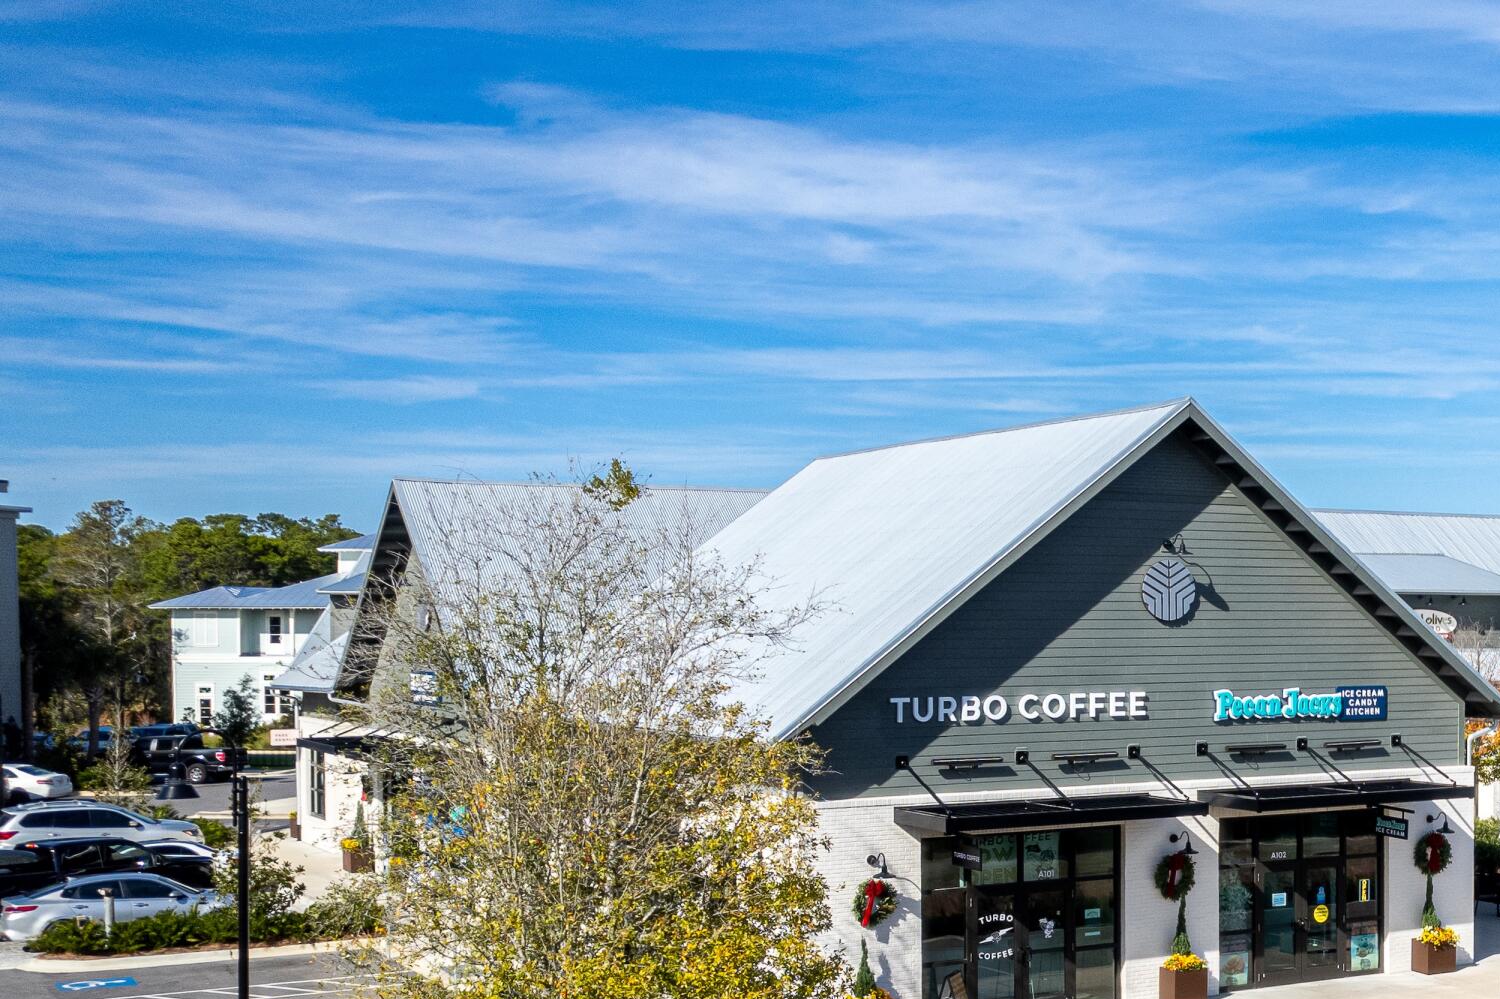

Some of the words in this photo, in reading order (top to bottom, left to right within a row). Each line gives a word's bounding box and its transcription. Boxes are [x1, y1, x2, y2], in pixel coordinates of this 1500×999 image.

[1341, 689, 1355, 698] ICE
[1355, 689, 1384, 698] CREAM
[889, 694, 1008, 724] TURBO
[1017, 691, 1147, 720] COFFEE
[1213, 689, 1282, 722] Pecan
[1282, 687, 1342, 720] Jacks
[1348, 699, 1378, 707] CANDY
[1345, 707, 1381, 716] KITCHEN
[1375, 826, 1385, 834] ICE
[1385, 828, 1405, 837] CREAM
[1271, 851, 1287, 859] A102
[1038, 870, 1055, 878] A101
[978, 913, 1014, 925] TURBO
[978, 948, 1014, 960] COFFEE
